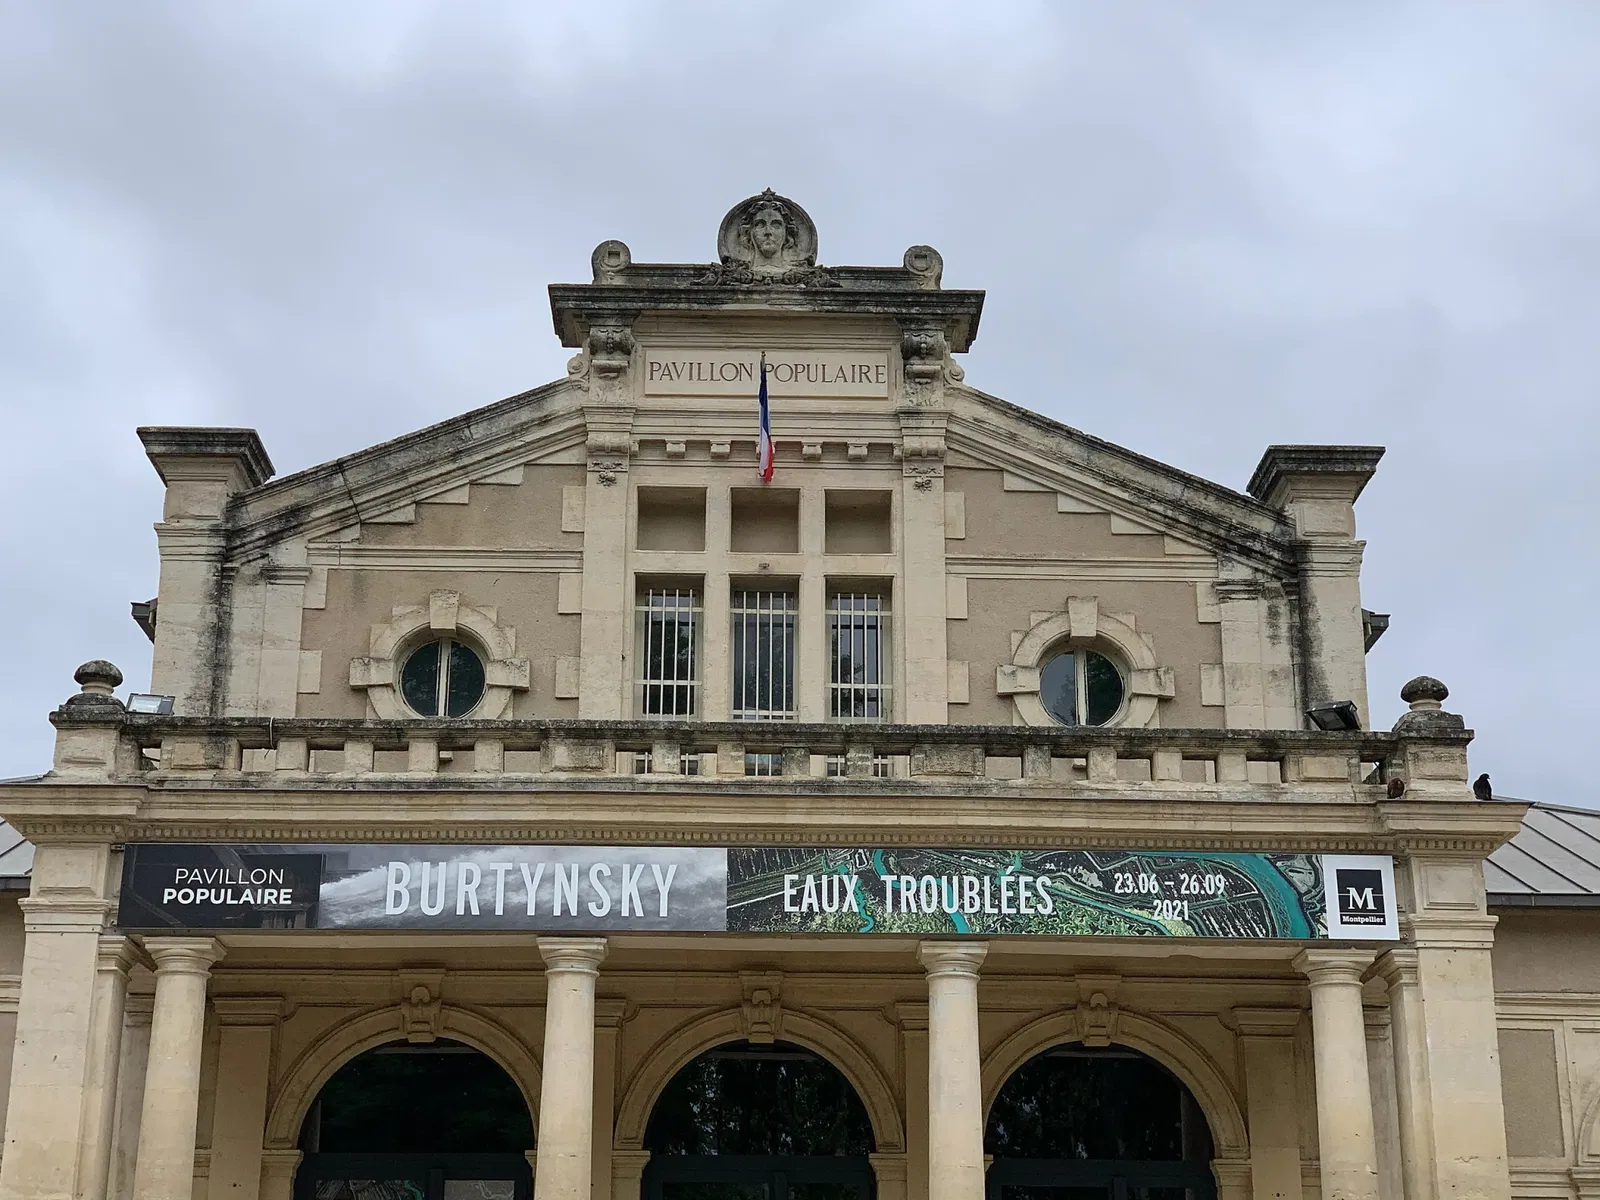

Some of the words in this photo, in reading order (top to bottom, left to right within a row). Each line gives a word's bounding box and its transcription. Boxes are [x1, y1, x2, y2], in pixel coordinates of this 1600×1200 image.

[649, 361, 753, 382] PAVILLON
[764, 363, 886, 384] POPULAIRE
[175, 868, 284, 885] PAVILLON
[1114, 872, 1159, 894] 23.06
[1180, 873, 1225, 895] 26.09
[163, 888, 292, 905] POPULAIRE
[385, 861, 678, 917] BURTYNSKY
[783, 874, 858, 913] EAUX
[881, 867, 1053, 914] TROUBLÉES
[1346, 887, 1377, 910] M
[1153, 899, 1190, 921] 2021
[1342, 915, 1385, 925] Montpellier
